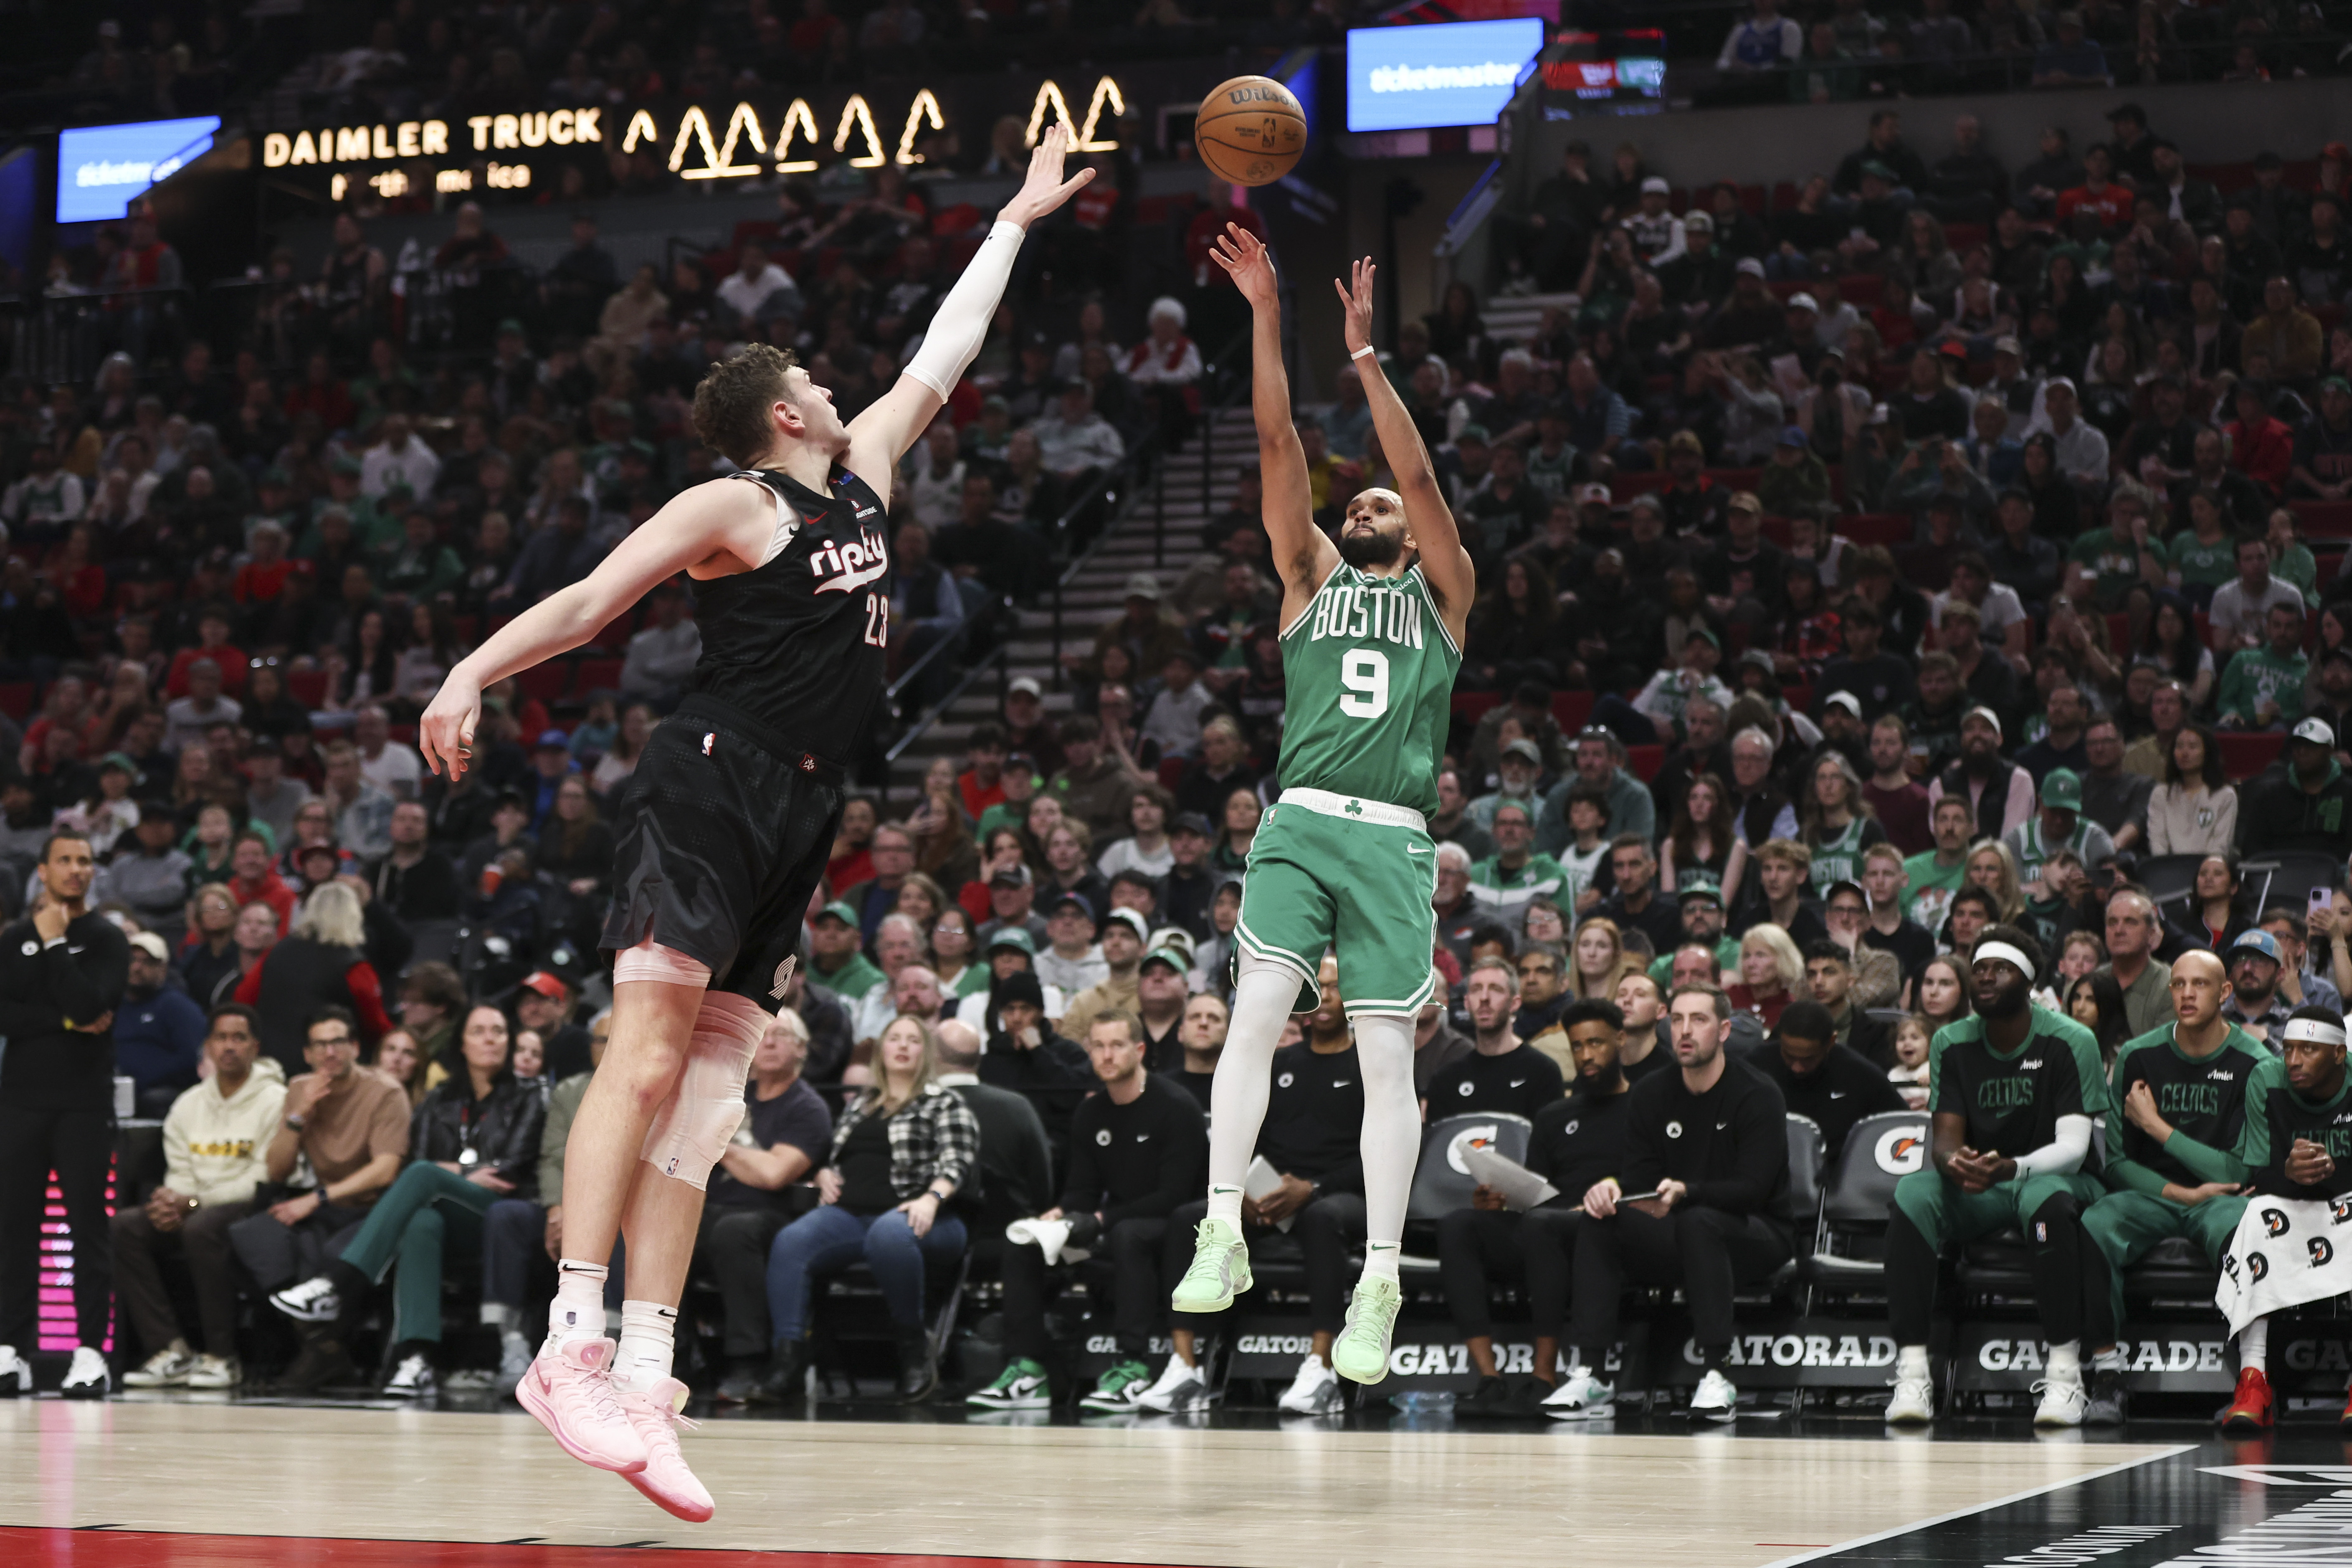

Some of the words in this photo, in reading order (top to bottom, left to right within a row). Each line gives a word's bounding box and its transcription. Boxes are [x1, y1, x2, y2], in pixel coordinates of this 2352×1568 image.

[263, 119, 448, 167] DAIMLER
[467, 107, 602, 151] TRUCK
[856, 506, 877, 519] IGHTSIDE
[865, 592, 889, 648] 23
[1311, 586, 1423, 650] BOSTON
[1339, 648, 1390, 719] 9
[1977, 1076, 2034, 1109] CELTICS
[2161, 1082, 2218, 1115] CELTICS
